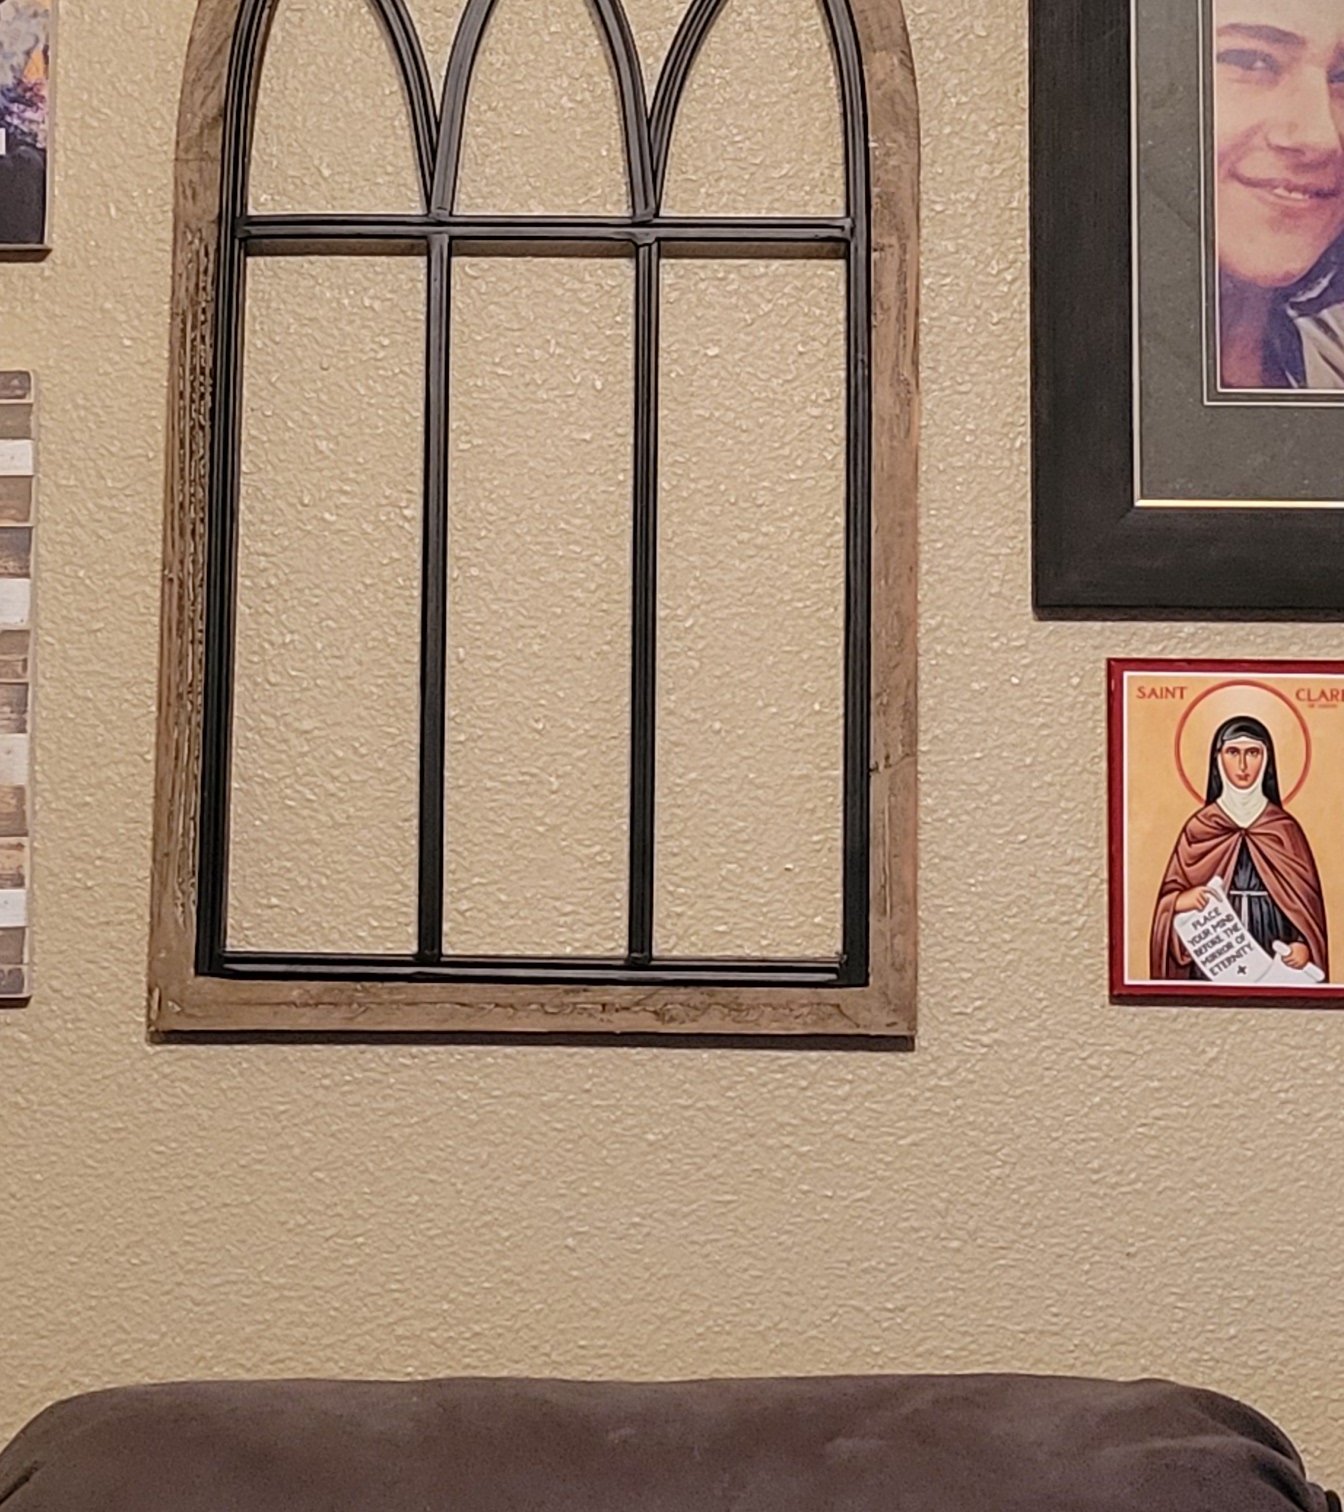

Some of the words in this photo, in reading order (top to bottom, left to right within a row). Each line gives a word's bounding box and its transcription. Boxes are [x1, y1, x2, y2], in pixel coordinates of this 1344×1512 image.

[1136, 686, 1188, 700] SAINT
[1187, 928, 1213, 947] YOUR
[1211, 913, 1235, 933] MIND
[1191, 906, 1222, 930] PLACE
[1193, 935, 1225, 957] BEFORE
[1223, 922, 1241, 938] THE
[1234, 932, 1245, 945] OF
[1209, 942, 1254, 976] ETERNITY
